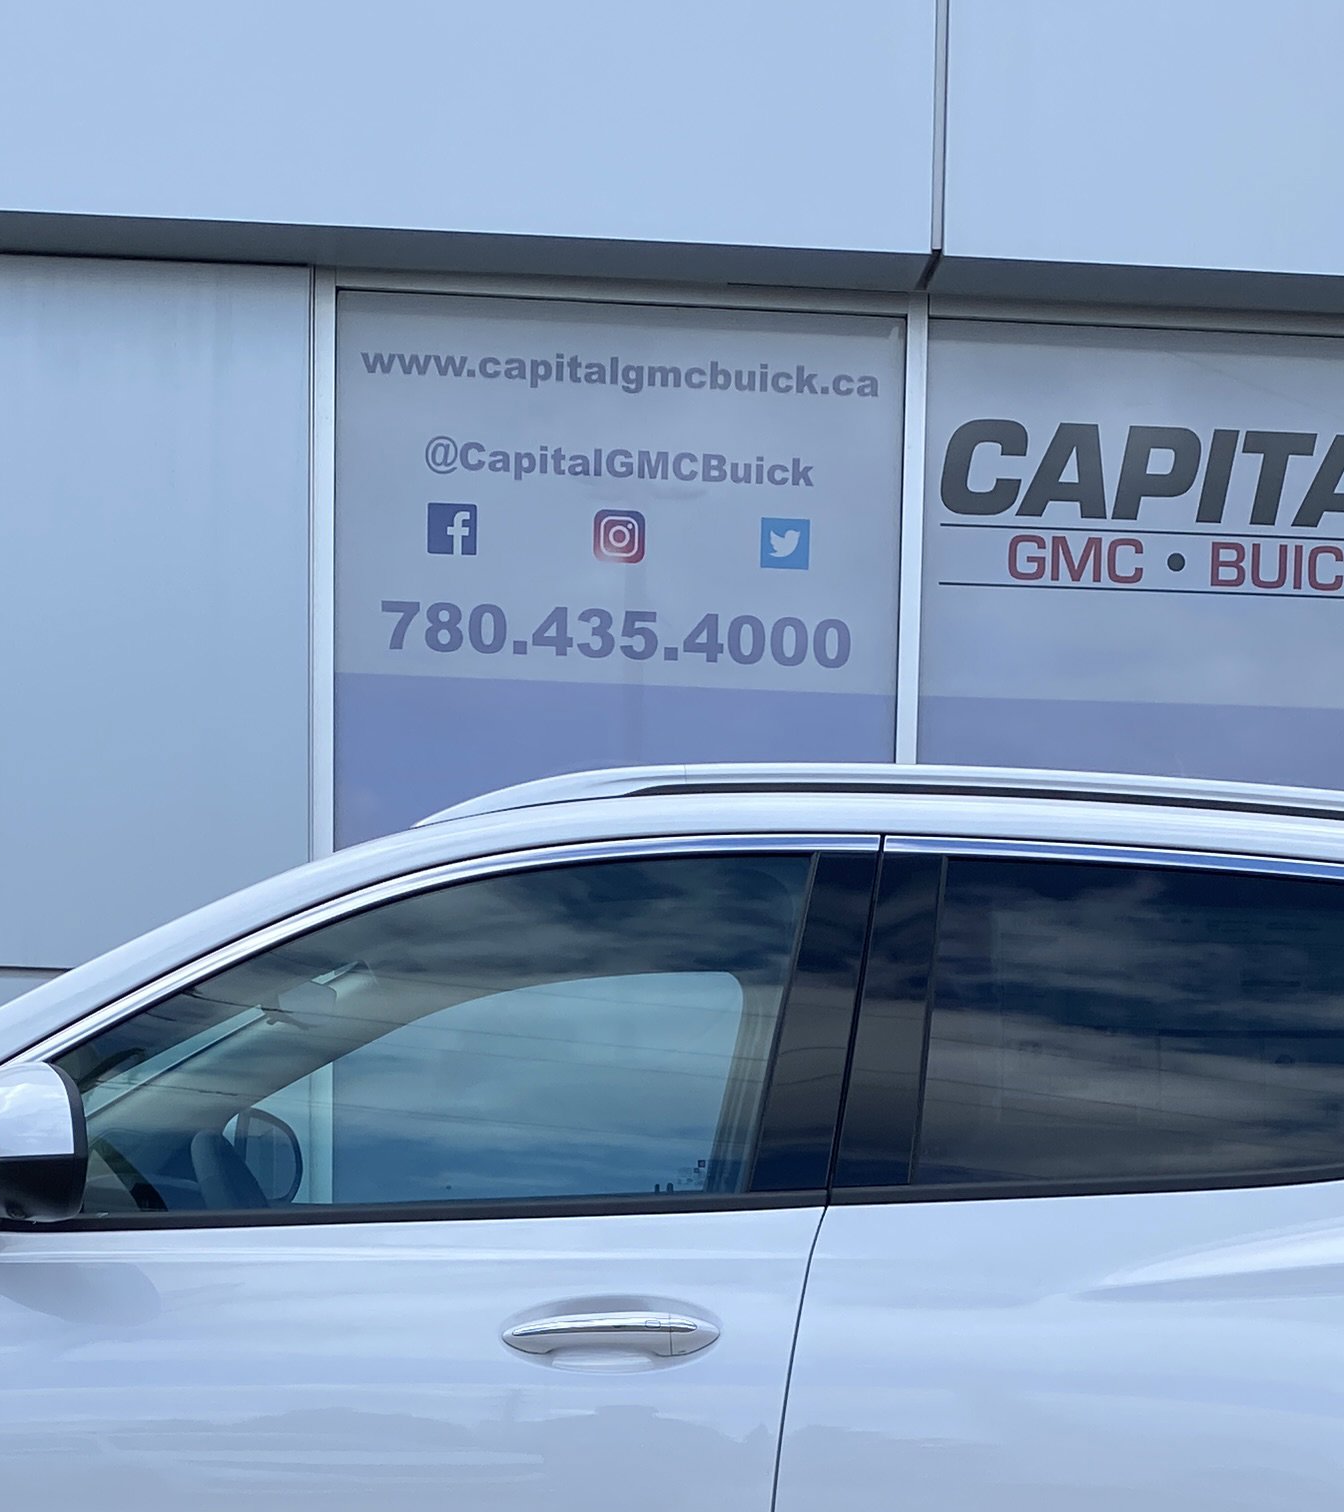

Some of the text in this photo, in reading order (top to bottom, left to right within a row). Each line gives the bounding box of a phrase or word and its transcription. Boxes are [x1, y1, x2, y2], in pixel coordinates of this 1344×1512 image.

[361, 350, 880, 398] www.capitalgmcbuick.ca
[425, 435, 814, 488] @CapitalGMCBuick
[1007, 534, 1144, 584] GMC
[381, 600, 852, 668] 780.435.4000
